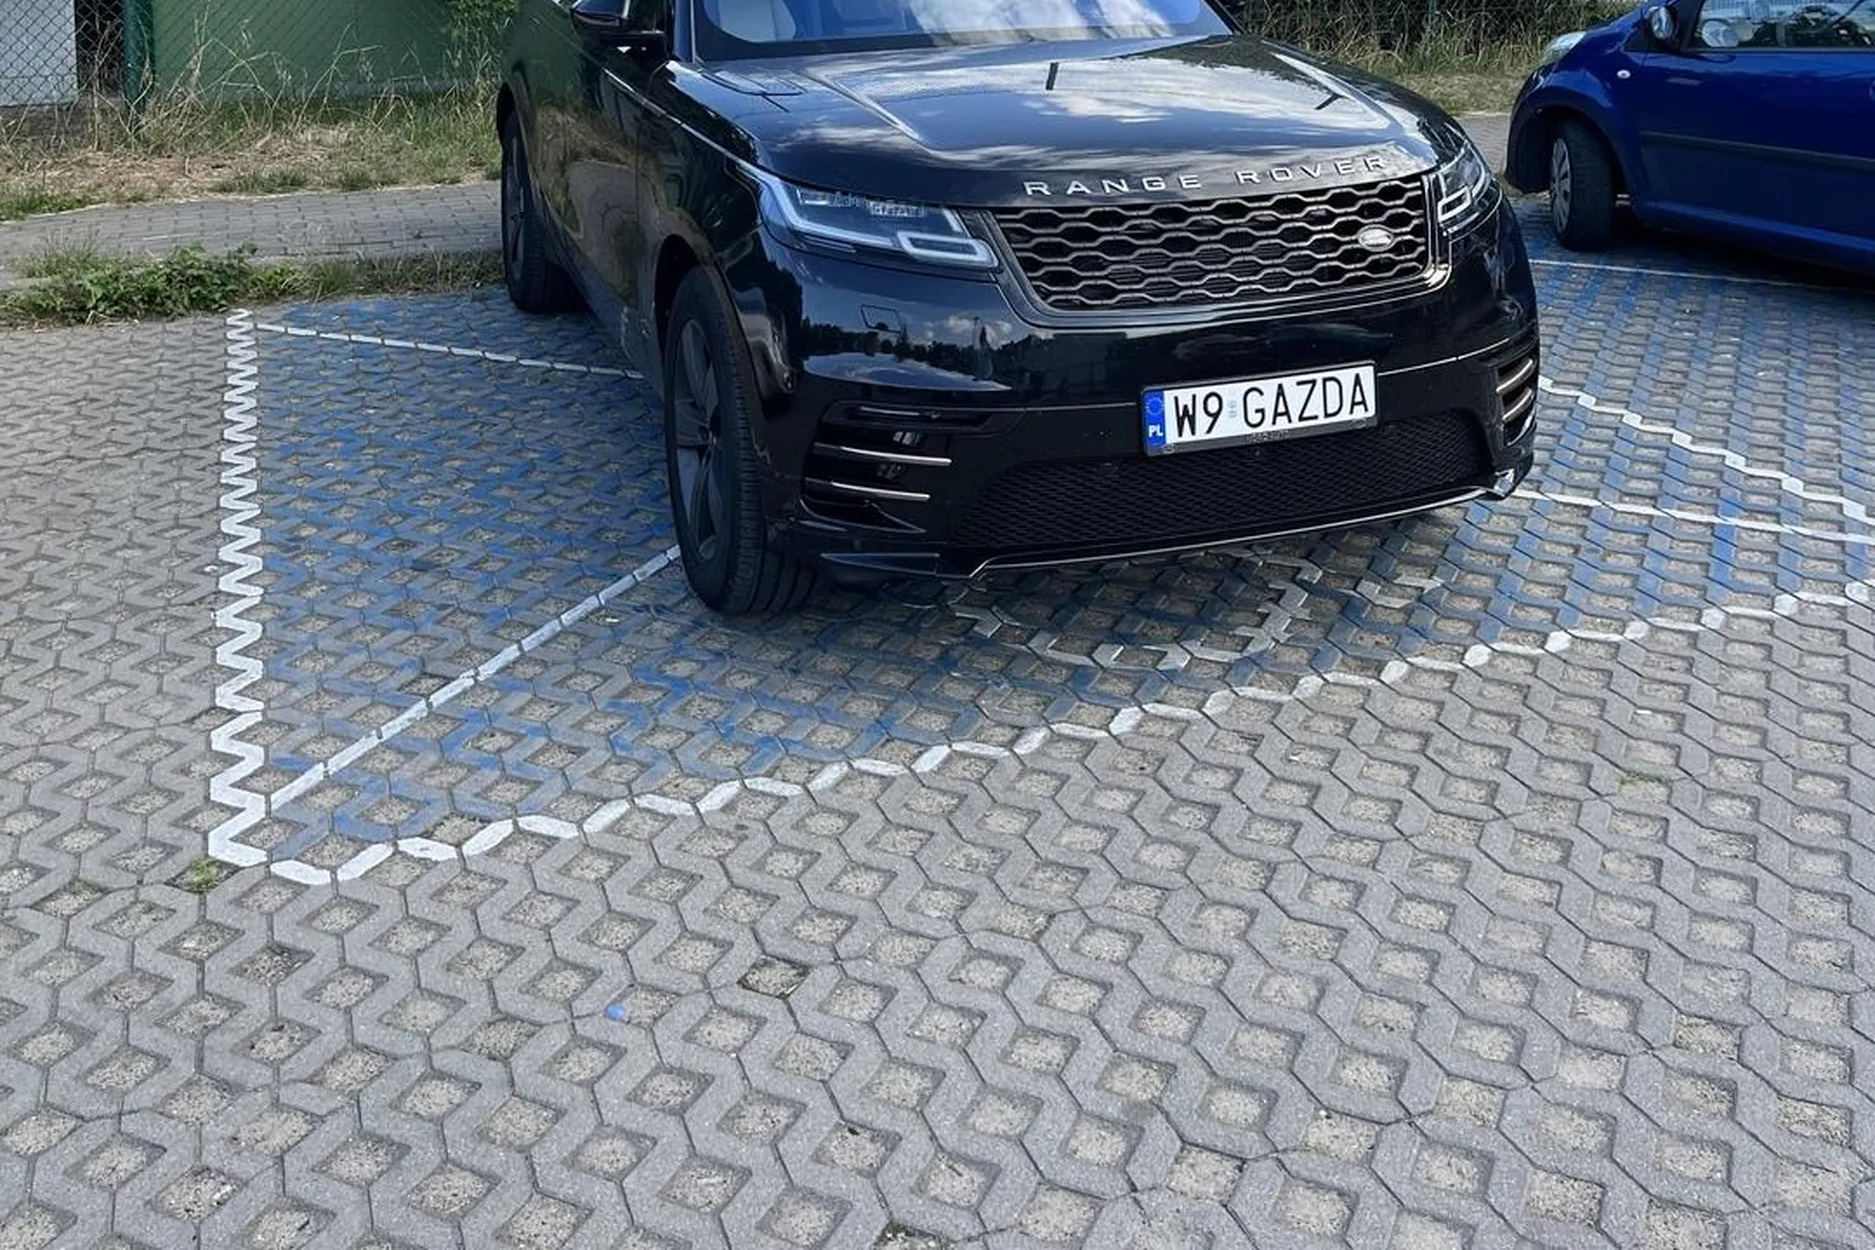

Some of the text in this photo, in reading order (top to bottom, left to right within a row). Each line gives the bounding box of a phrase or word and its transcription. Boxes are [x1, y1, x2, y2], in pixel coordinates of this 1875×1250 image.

[1023, 157, 1387, 196] RANGE ROVER
[1173, 372, 1369, 438] W9 GAZDA
[1148, 425, 1164, 437] PL
